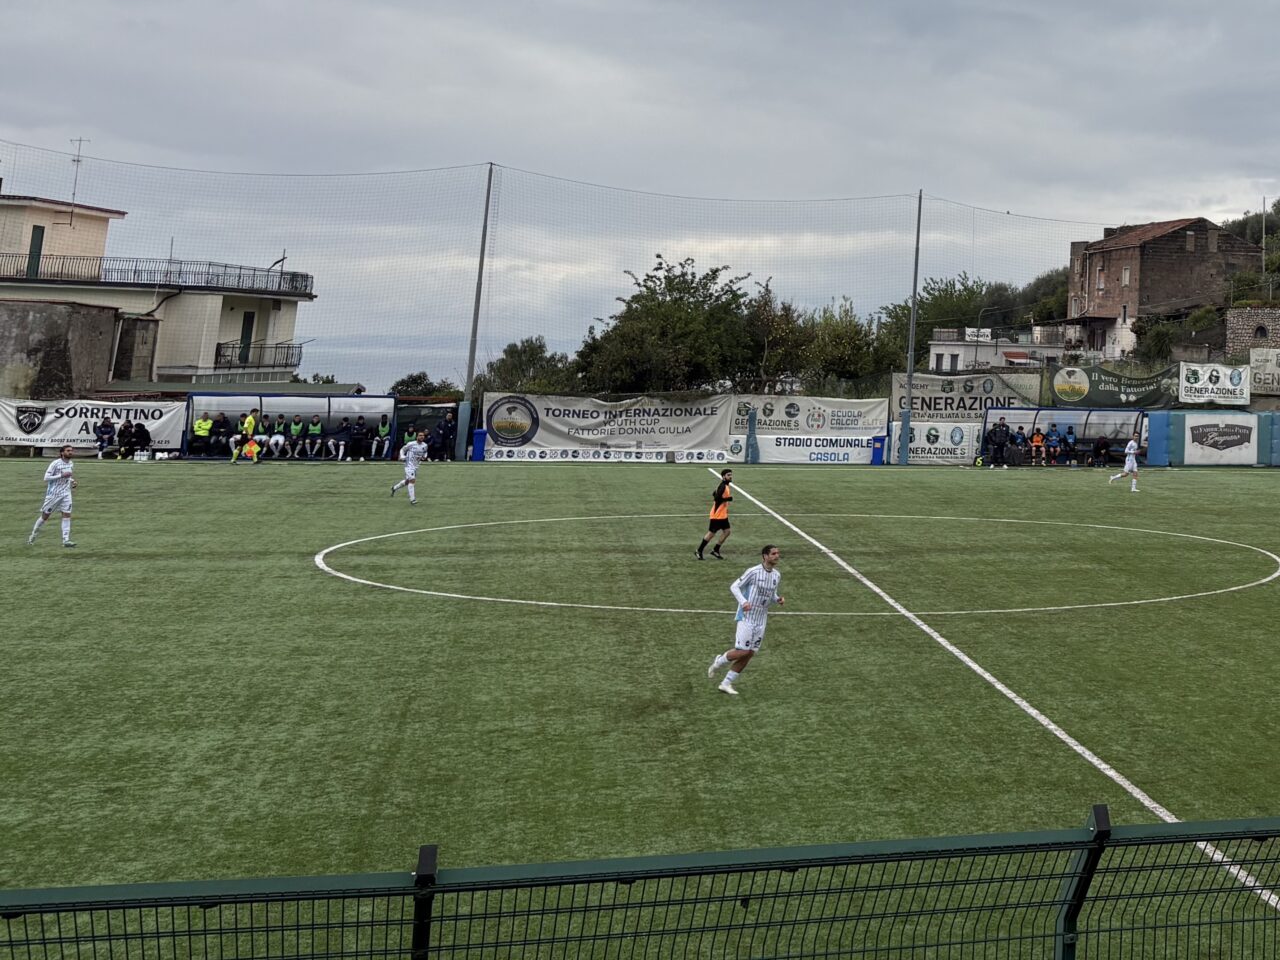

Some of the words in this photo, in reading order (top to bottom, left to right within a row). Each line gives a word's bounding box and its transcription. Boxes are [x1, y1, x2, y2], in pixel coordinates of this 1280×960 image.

[1098, 383, 1119, 392] dalla
[1184, 386, 1238, 396] GENERAZIONE
[54, 406, 164, 420] SORRENTINO
[544, 408, 600, 420] TORNEO
[604, 406, 718, 420] INTERNAZIONALE
[602, 418, 636, 427] YOUTH
[638, 418, 660, 426] CUP
[794, 420, 800, 428] S
[568, 427, 616, 436] FATTORIE
[618, 427, 656, 435] DONNA
[658, 426, 692, 434] GIULIA
[776, 437, 812, 447] STADIO
[814, 438, 872, 448] COMUNALE
[809, 452, 850, 462] CASOLA
[960, 448, 966, 456] S
